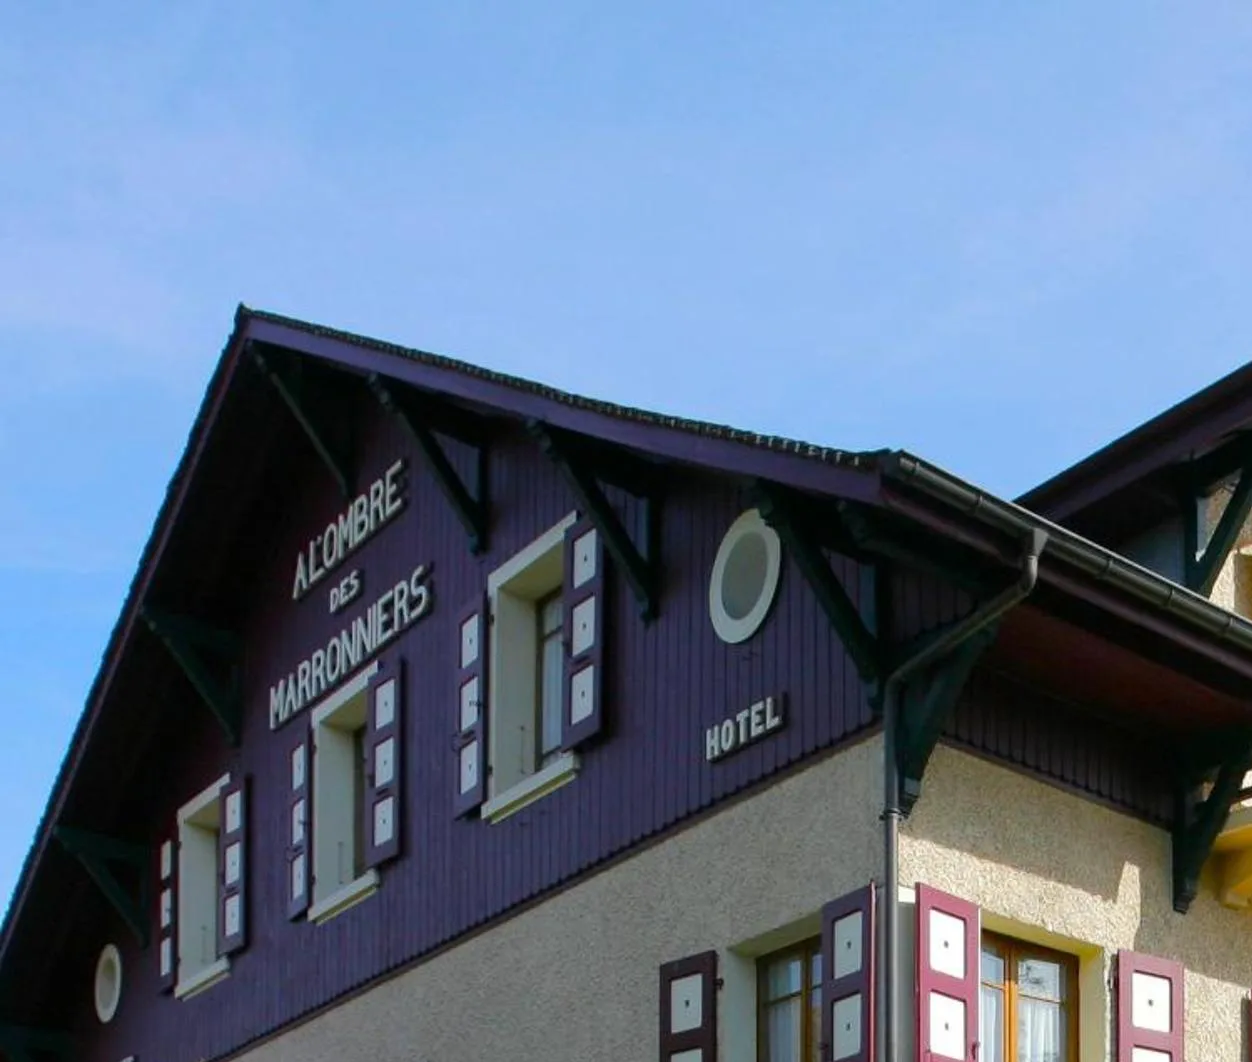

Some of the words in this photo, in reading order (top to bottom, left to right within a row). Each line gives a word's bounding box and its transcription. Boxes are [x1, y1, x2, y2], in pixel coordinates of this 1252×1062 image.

[329, 569, 360, 613] DES
[270, 565, 428, 730] MARRONNIERS
[706, 696, 780, 760] HOTEL
